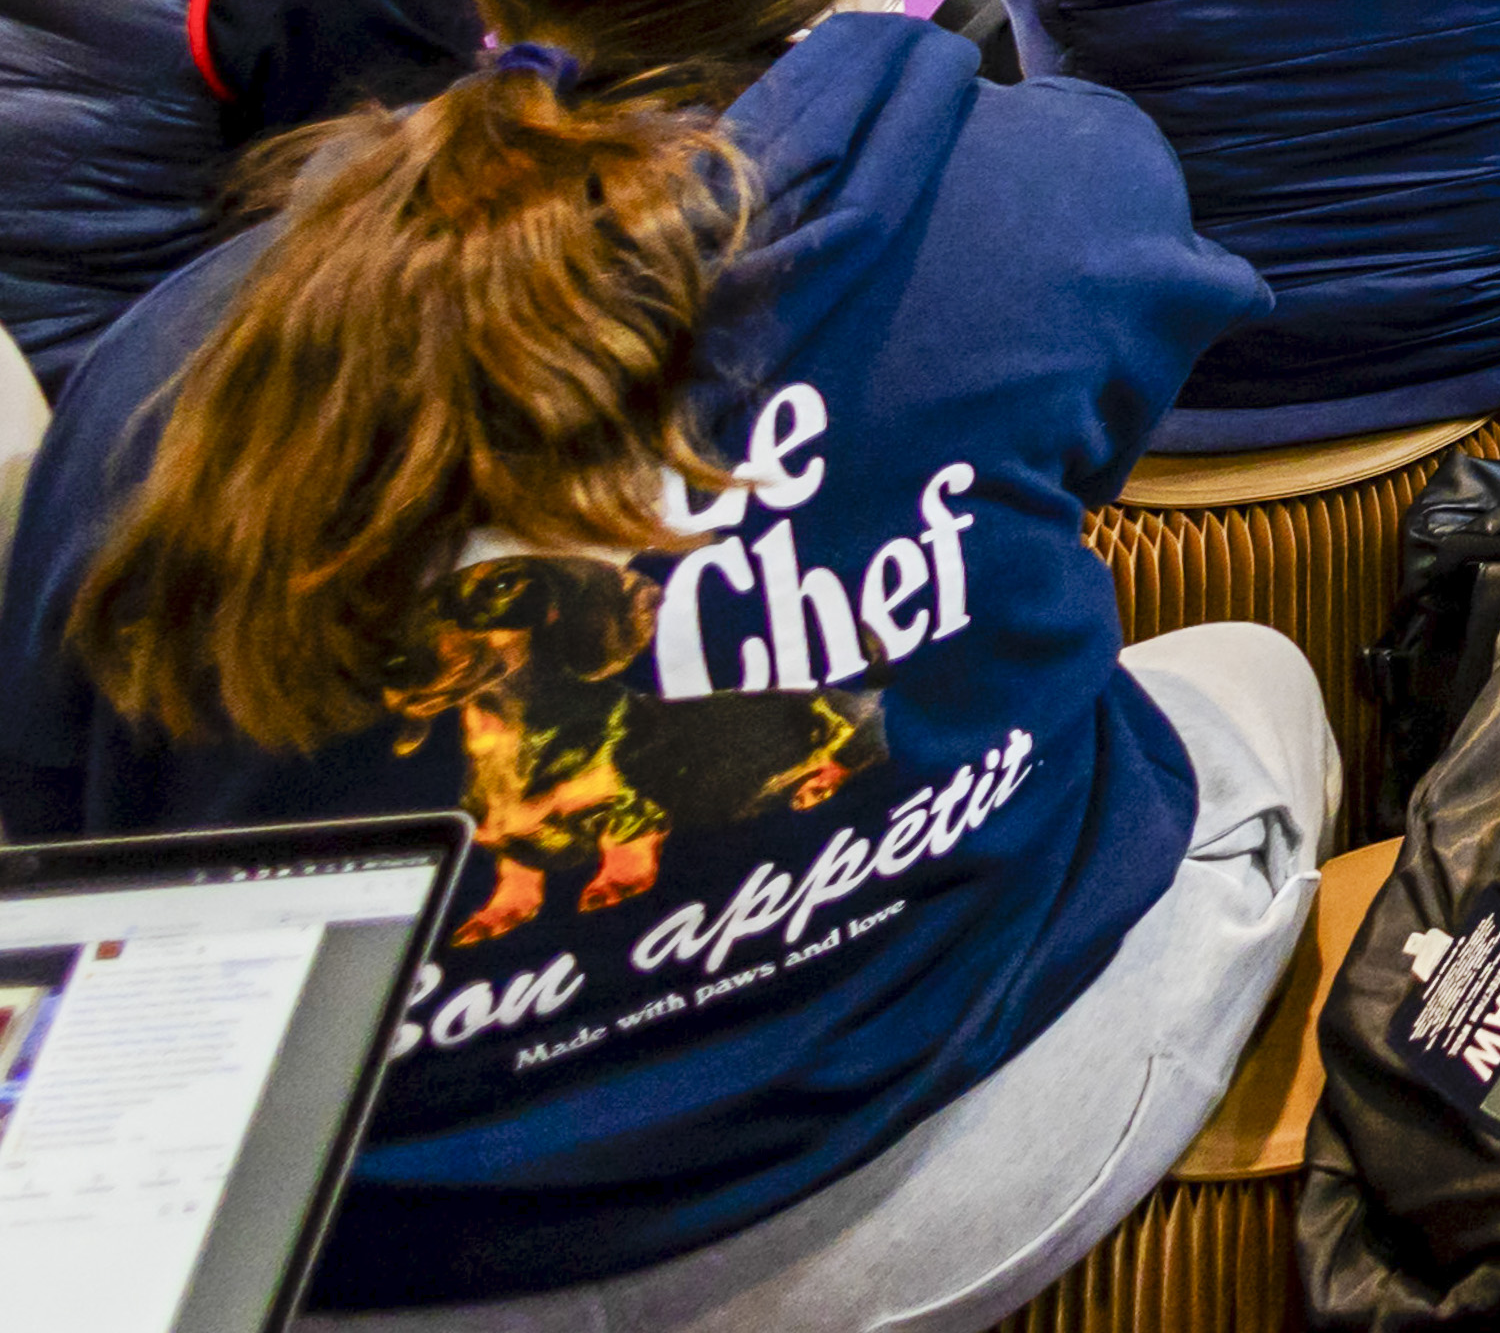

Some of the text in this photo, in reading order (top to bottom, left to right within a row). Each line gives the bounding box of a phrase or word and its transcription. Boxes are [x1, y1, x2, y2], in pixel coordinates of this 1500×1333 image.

[655, 461, 975, 701] Chef
[631, 727, 1034, 974] appétit
[515, 899, 907, 1071] Made with paws and love
